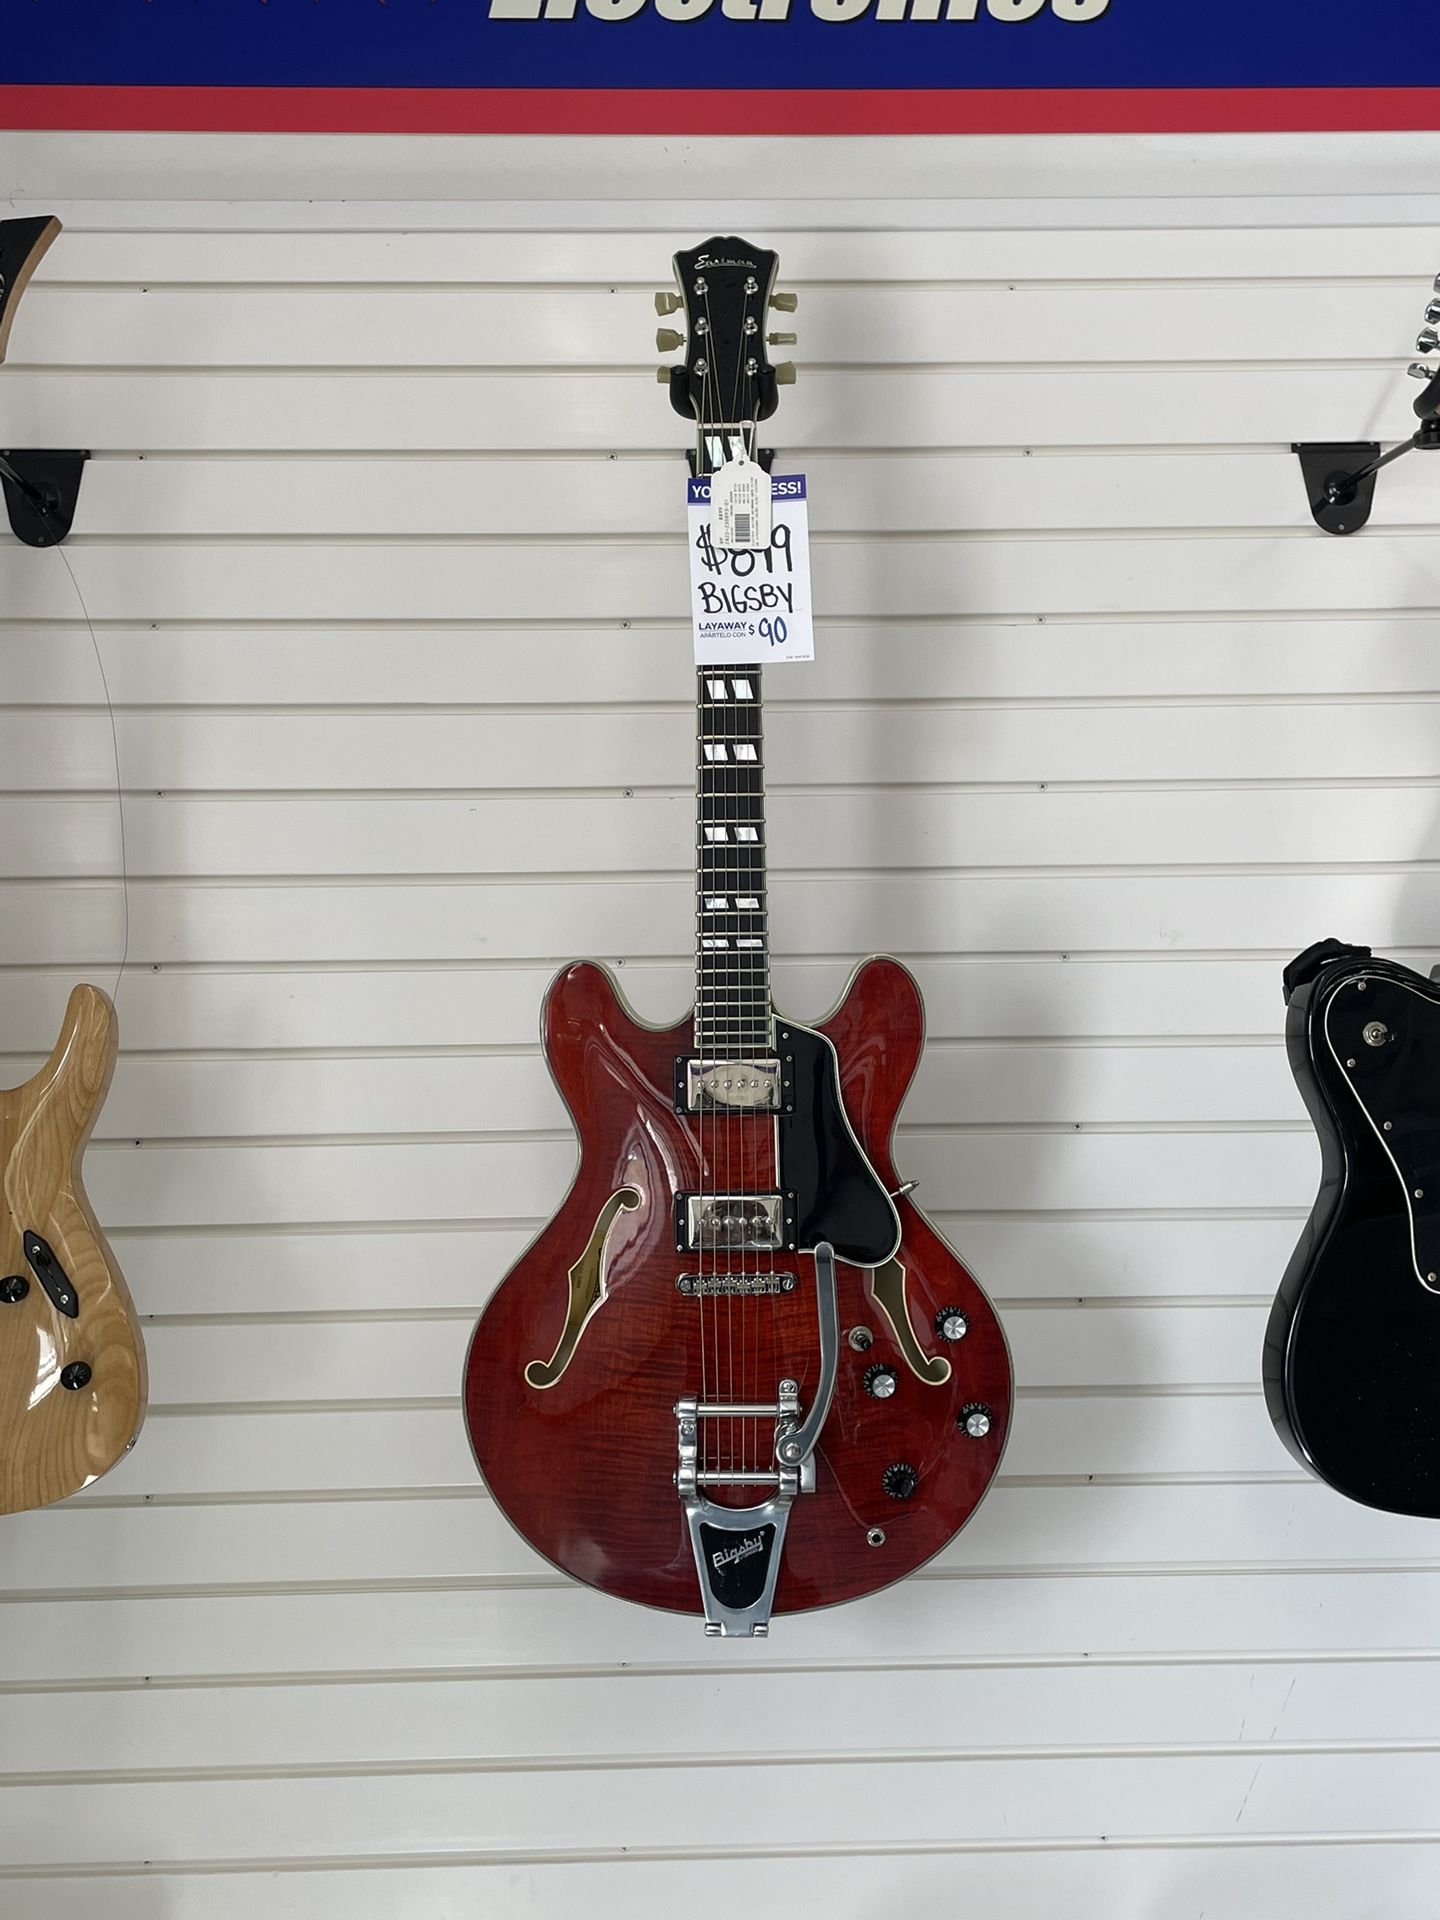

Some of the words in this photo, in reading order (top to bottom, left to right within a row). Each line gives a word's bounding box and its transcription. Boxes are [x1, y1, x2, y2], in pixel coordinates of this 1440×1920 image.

[692, 485, 711, 498] YO
[772, 481, 802, 495] ESS!
[698, 582, 793, 613] BIGSBY
[699, 621, 747, 630] LAYAWAY
[712, 1533, 764, 1567] Bigsby
